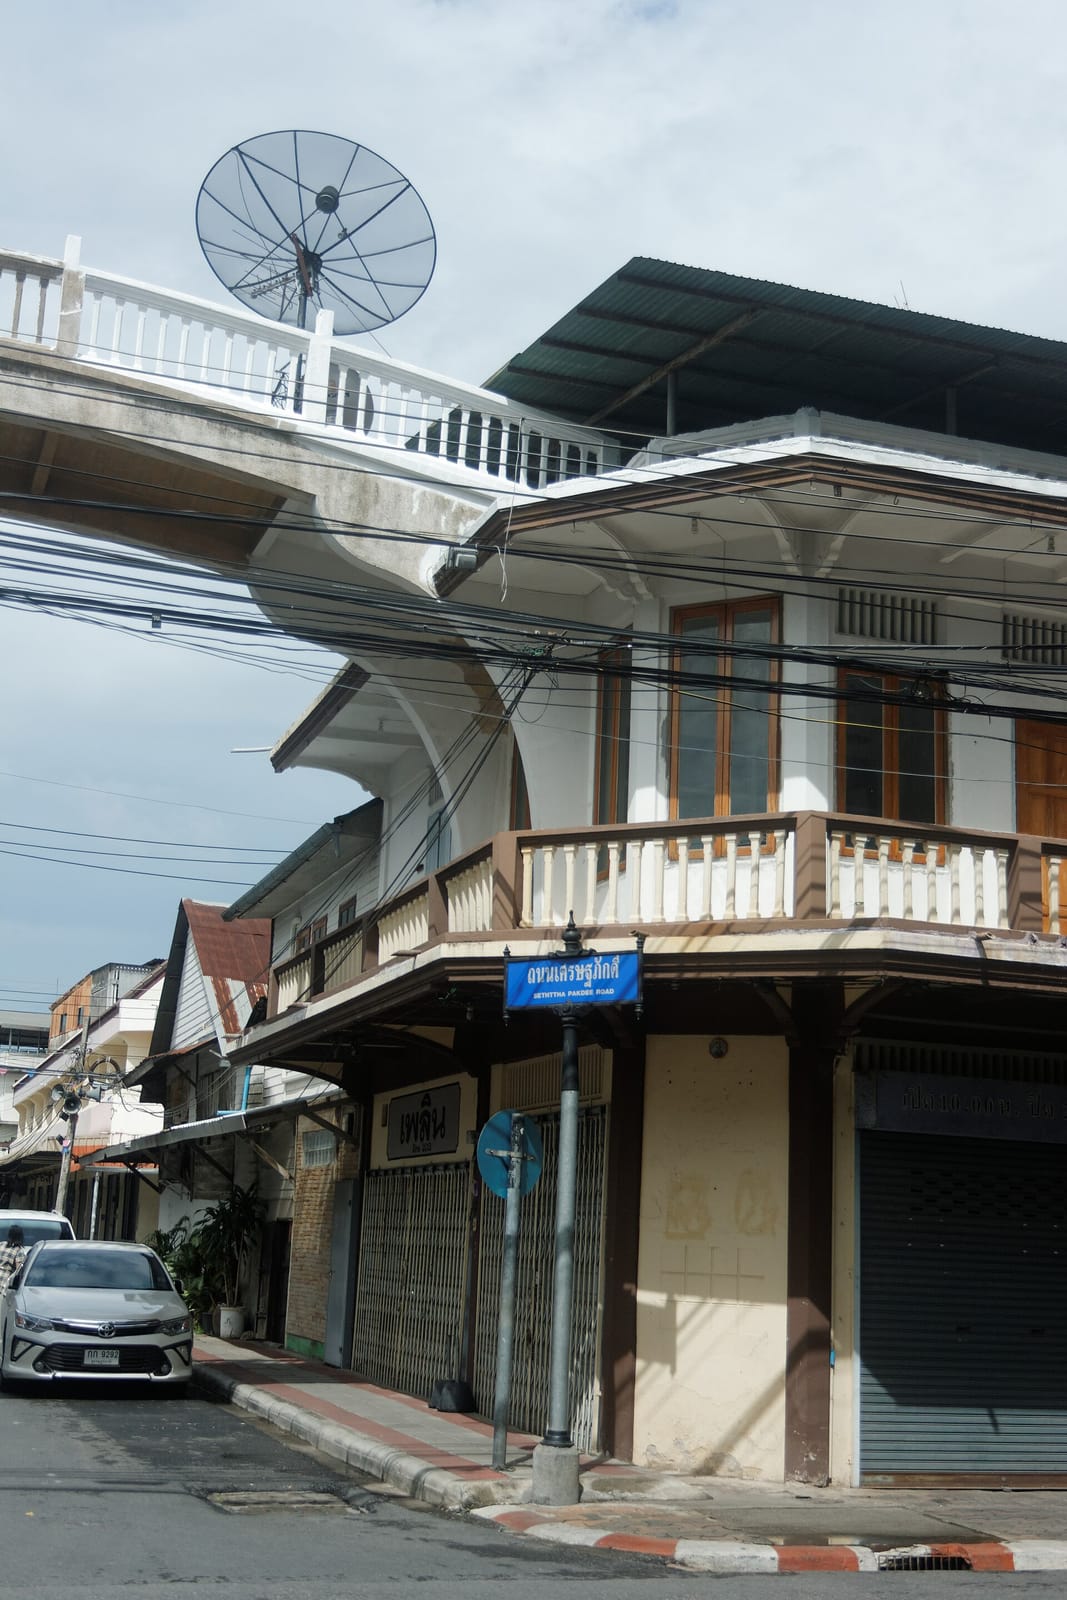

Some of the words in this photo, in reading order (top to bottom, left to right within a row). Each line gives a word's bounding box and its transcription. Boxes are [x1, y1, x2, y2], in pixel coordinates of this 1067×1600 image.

[527, 956, 620, 987] ถนนเศรษฐภักดี
[567, 989, 593, 997] PAKDEE
[595, 988, 615, 996] ROAD
